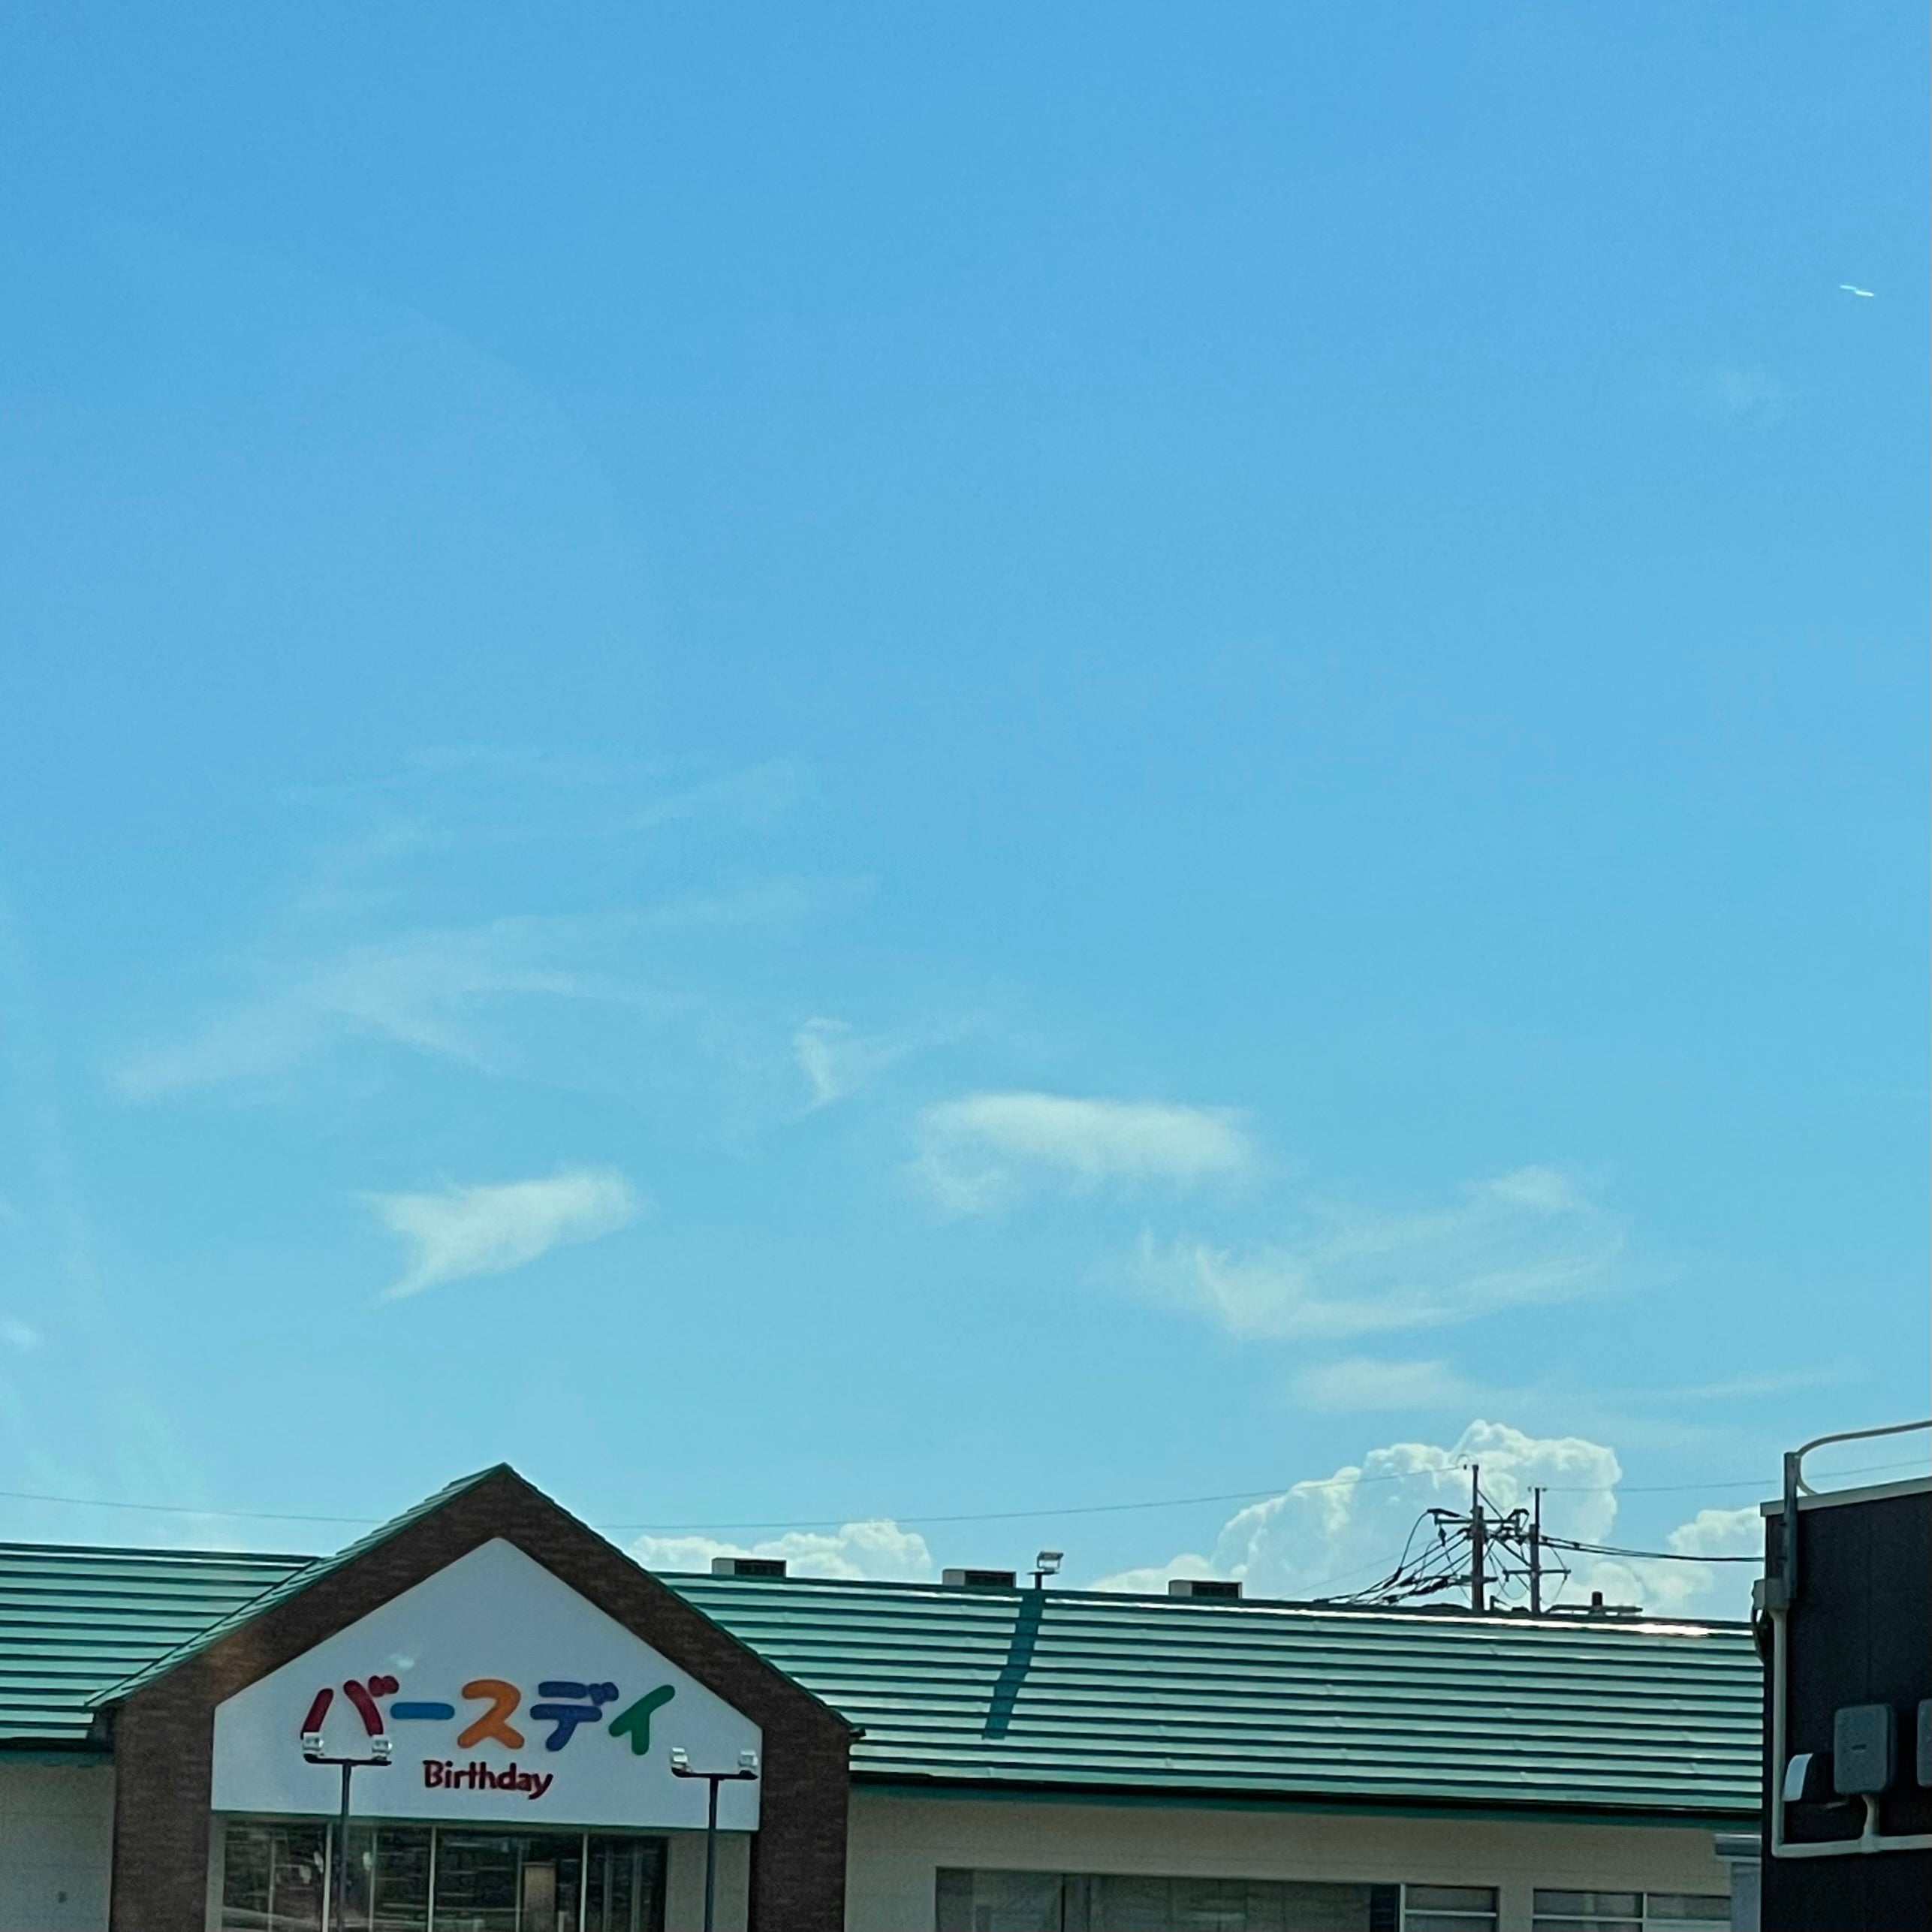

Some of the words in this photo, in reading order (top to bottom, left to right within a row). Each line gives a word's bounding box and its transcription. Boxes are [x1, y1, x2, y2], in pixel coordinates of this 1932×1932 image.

[301, 1675, 676, 1756] バースデイ
[423, 1759, 553, 1800] Birthday
